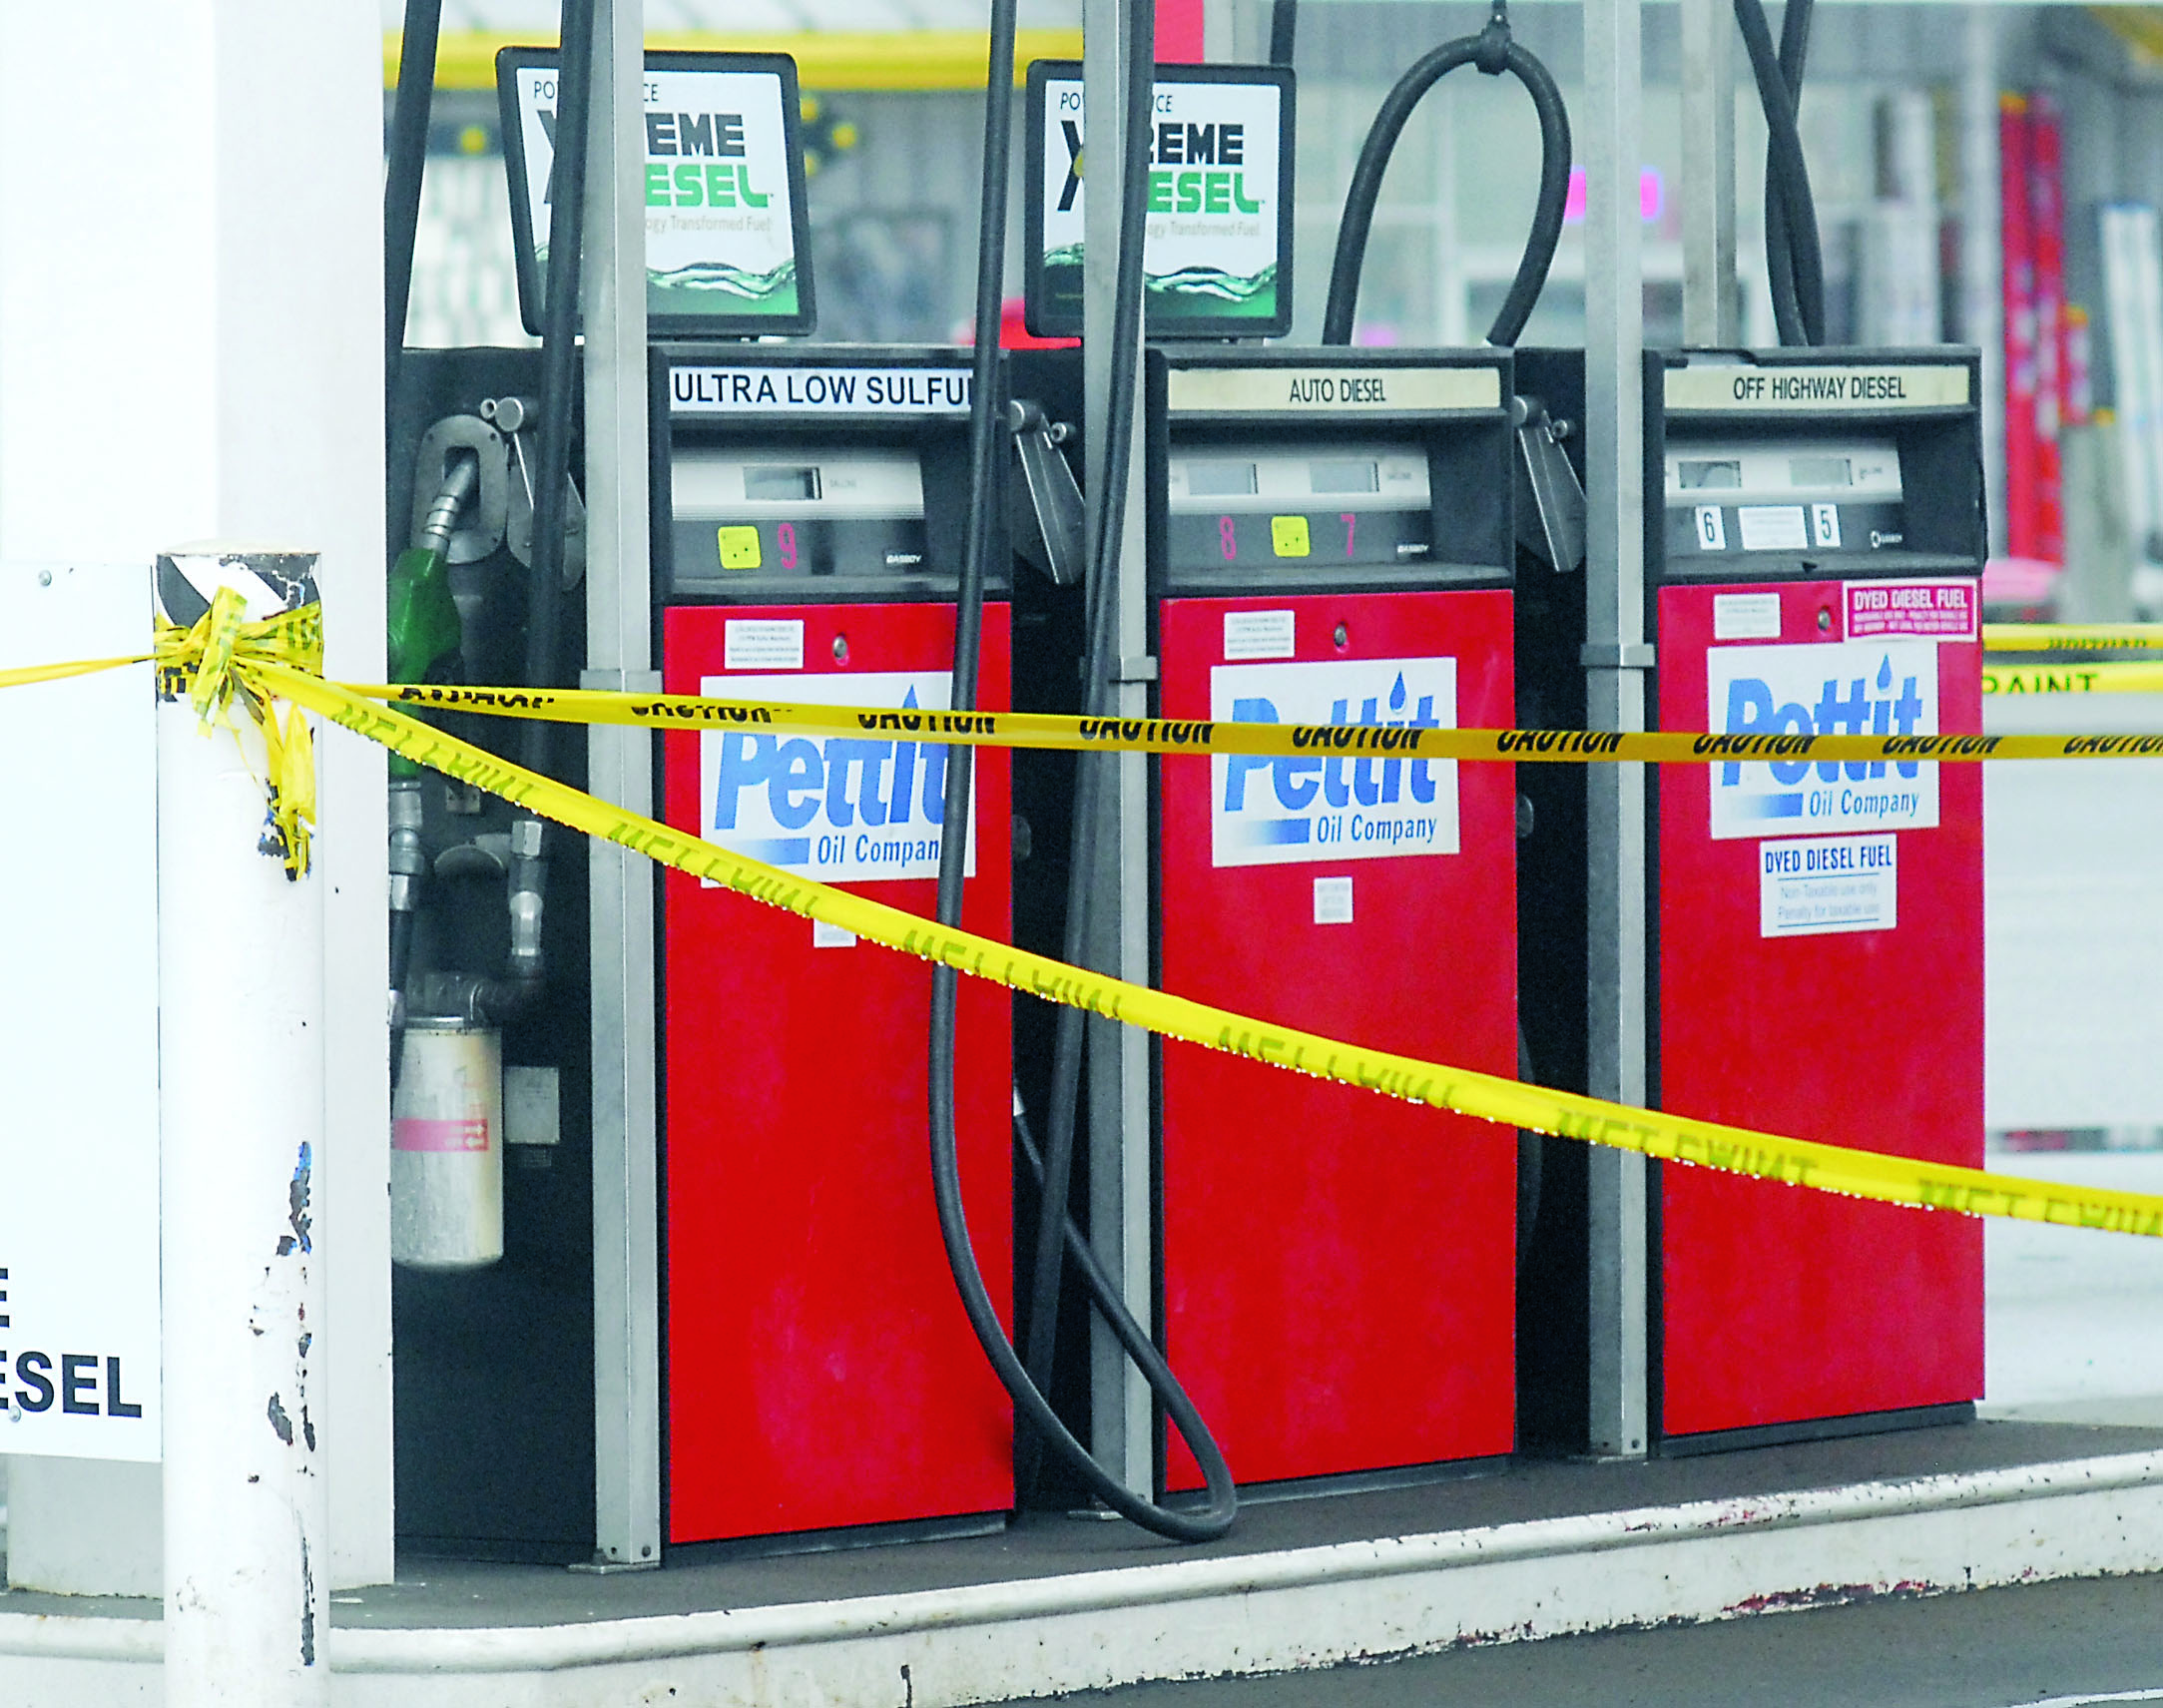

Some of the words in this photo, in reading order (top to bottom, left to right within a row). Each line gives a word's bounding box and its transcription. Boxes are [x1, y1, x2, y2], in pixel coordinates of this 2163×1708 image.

[670, 215, 744, 234] Transformed
[674, 373, 778, 404] ULTRA
[787, 375, 856, 405] LOW
[1290, 378, 1335, 402] AUTO
[1340, 379, 1386, 401] DIESEL
[1733, 376, 1766, 400] OFF
[1772, 376, 1847, 400] HIGHWAY
[1851, 376, 1906, 399] DIESEL
[1220, 515, 1237, 560] 8
[1341, 513, 1355, 557] 7
[1703, 511, 1716, 543] 6
[1820, 509, 1833, 540] 5
[778, 522, 798, 569] 9
[1854, 589, 1889, 612] DYED
[1891, 587, 1934, 609] DIESEL
[1936, 587, 1968, 608] FUEL
[1224, 671, 1439, 812] Pettit
[1811, 791, 1833, 817] Oil
[1841, 786, 1919, 819] Company
[1317, 816, 1343, 844] Oil
[1351, 813, 1437, 846] Company
[817, 836, 846, 864] Oil
[855, 833, 941, 867] Compan
[1766, 851, 1801, 873] DYED
[1807, 847, 1855, 871] DIESEL
[1860, 845, 1893, 868] FUEL
[0, 1350, 142, 1419] SEL
